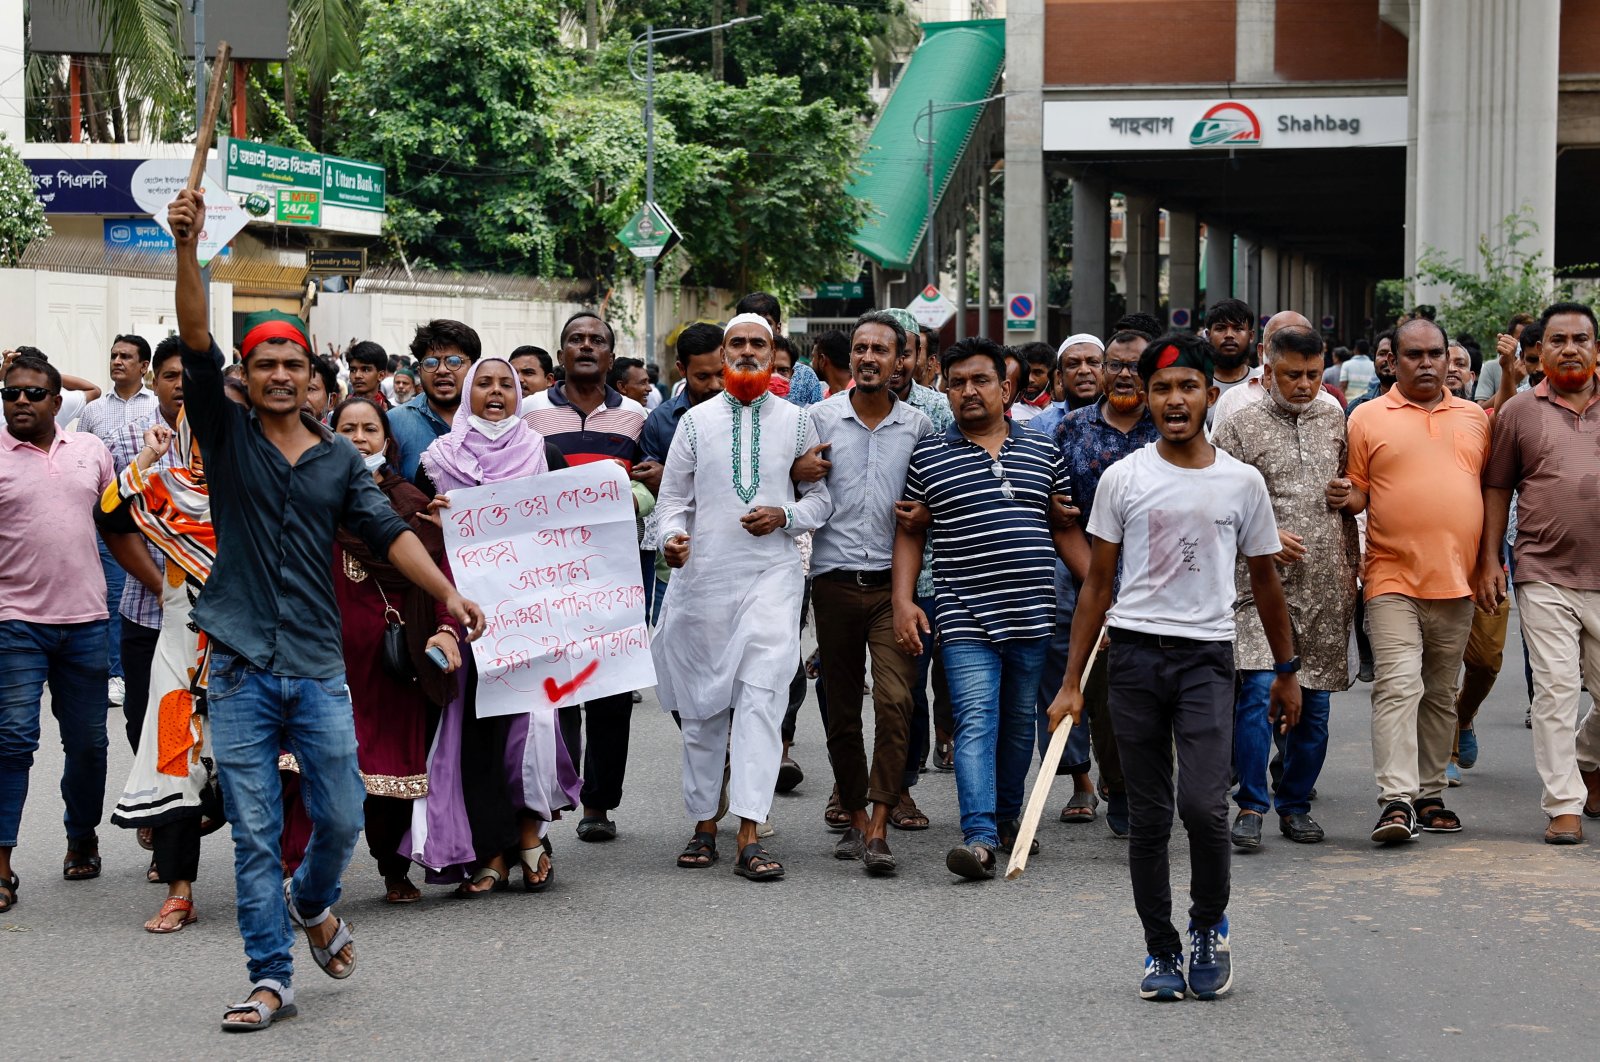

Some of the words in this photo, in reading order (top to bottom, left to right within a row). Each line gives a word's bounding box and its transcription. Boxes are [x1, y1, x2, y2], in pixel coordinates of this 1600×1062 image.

[1109, 117, 1174, 135] শাহবাগ
[1277, 115, 1360, 135] Shahbag
[57, 170, 107, 188] পিএলসি
[335, 170, 356, 189] Uttara
[357, 173, 373, 192] Bank
[249, 197, 267, 209] ATM
[292, 192, 317, 202] MTB
[282, 203, 309, 214] 24/7
[135, 227, 159, 238] জনতা
[136, 240, 169, 248] Janata
[311, 257, 341, 267] Laundry
[342, 257, 360, 267] Shop
[514, 495, 549, 517] ভয়
[456, 540, 519, 569] বিজয়
[532, 525, 608, 549] আছে
